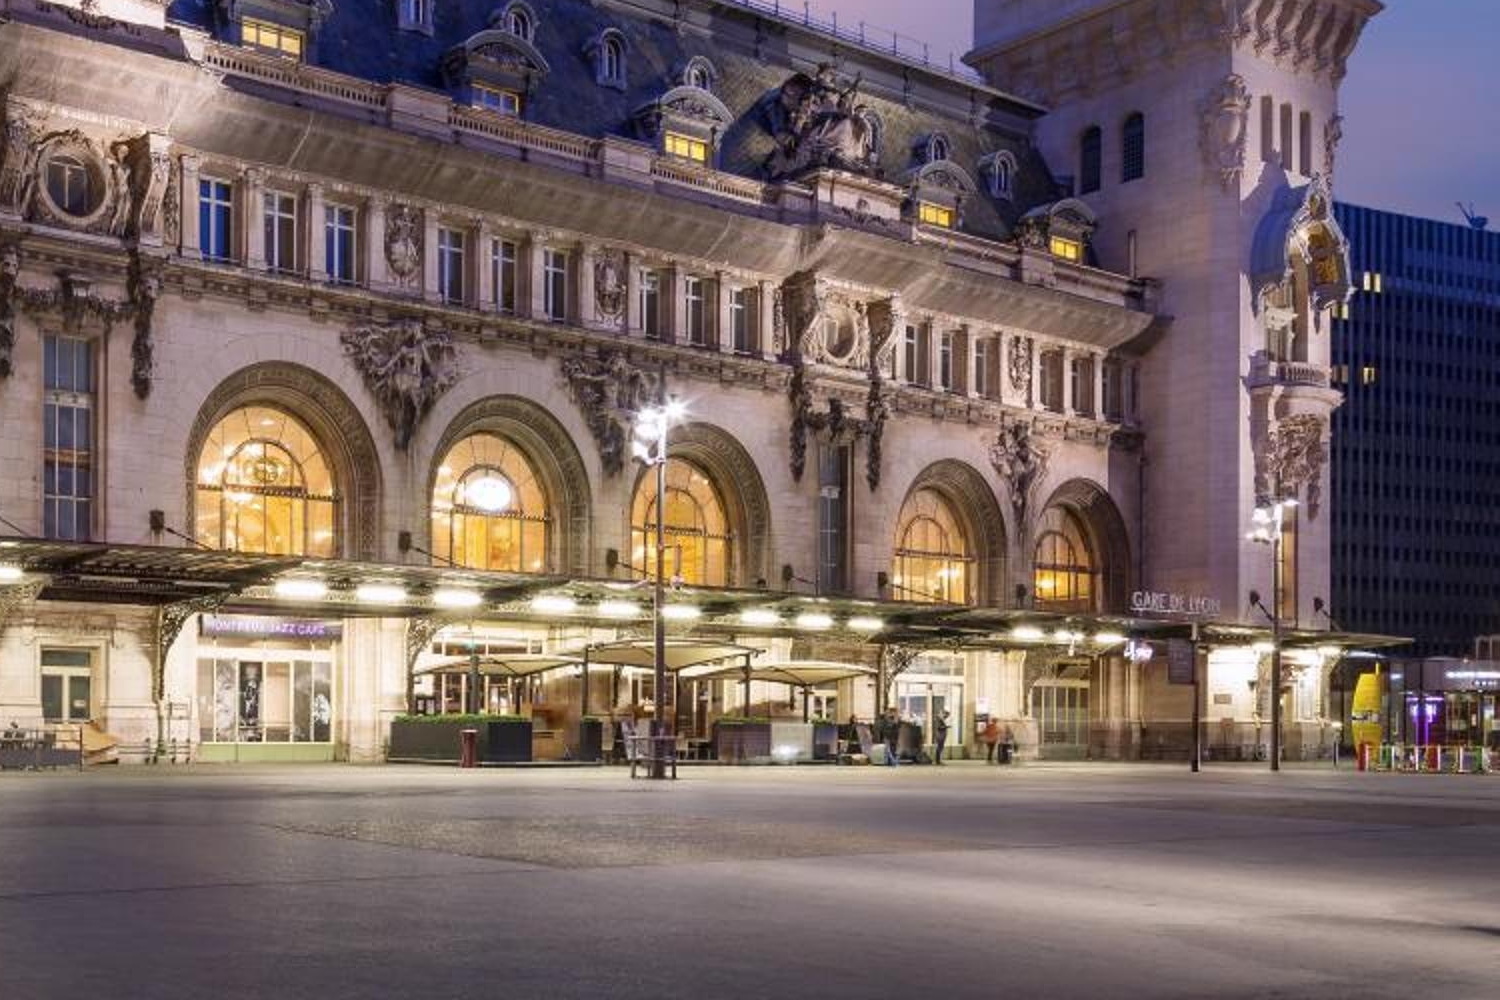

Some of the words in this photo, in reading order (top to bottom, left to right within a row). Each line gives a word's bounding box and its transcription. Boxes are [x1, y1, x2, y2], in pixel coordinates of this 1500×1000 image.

[1132, 591, 1167, 609] GARE
[1170, 593, 1185, 611] DE
[1189, 595, 1220, 613] LYON
